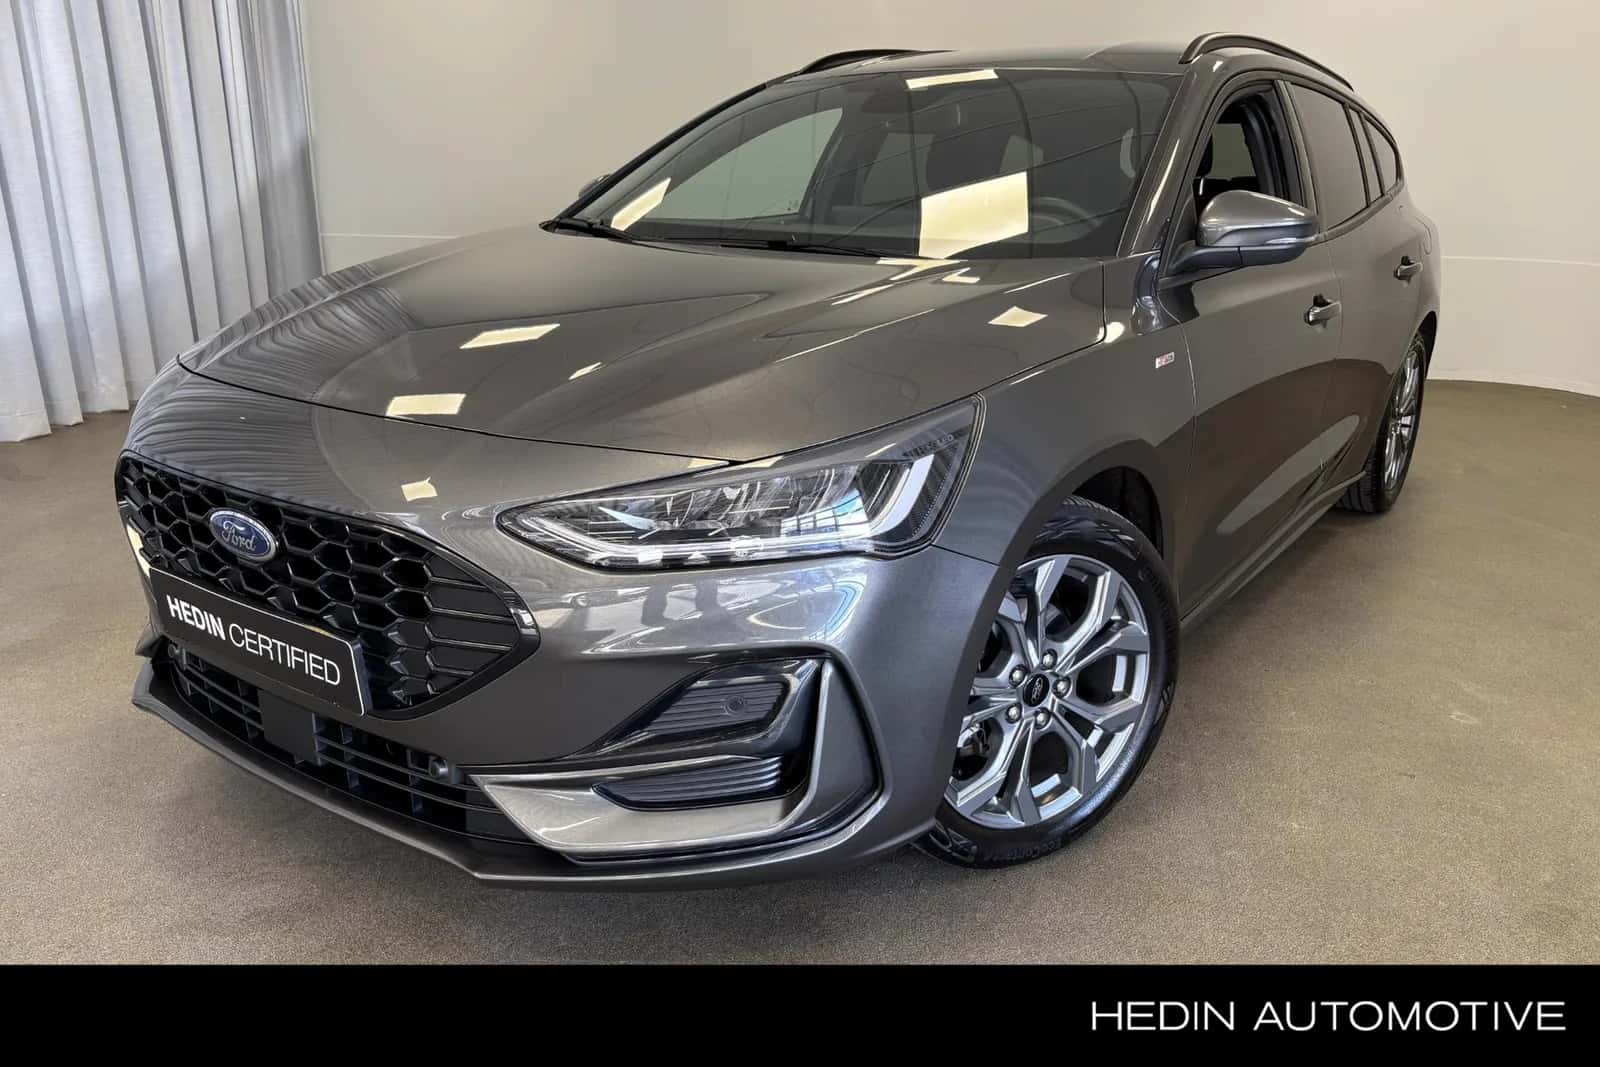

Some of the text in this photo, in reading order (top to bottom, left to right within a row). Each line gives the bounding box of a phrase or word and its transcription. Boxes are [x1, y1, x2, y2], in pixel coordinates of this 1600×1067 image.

[222, 520, 256, 551] Ford
[166, 594, 341, 686] HEDIN CERTIFIED
